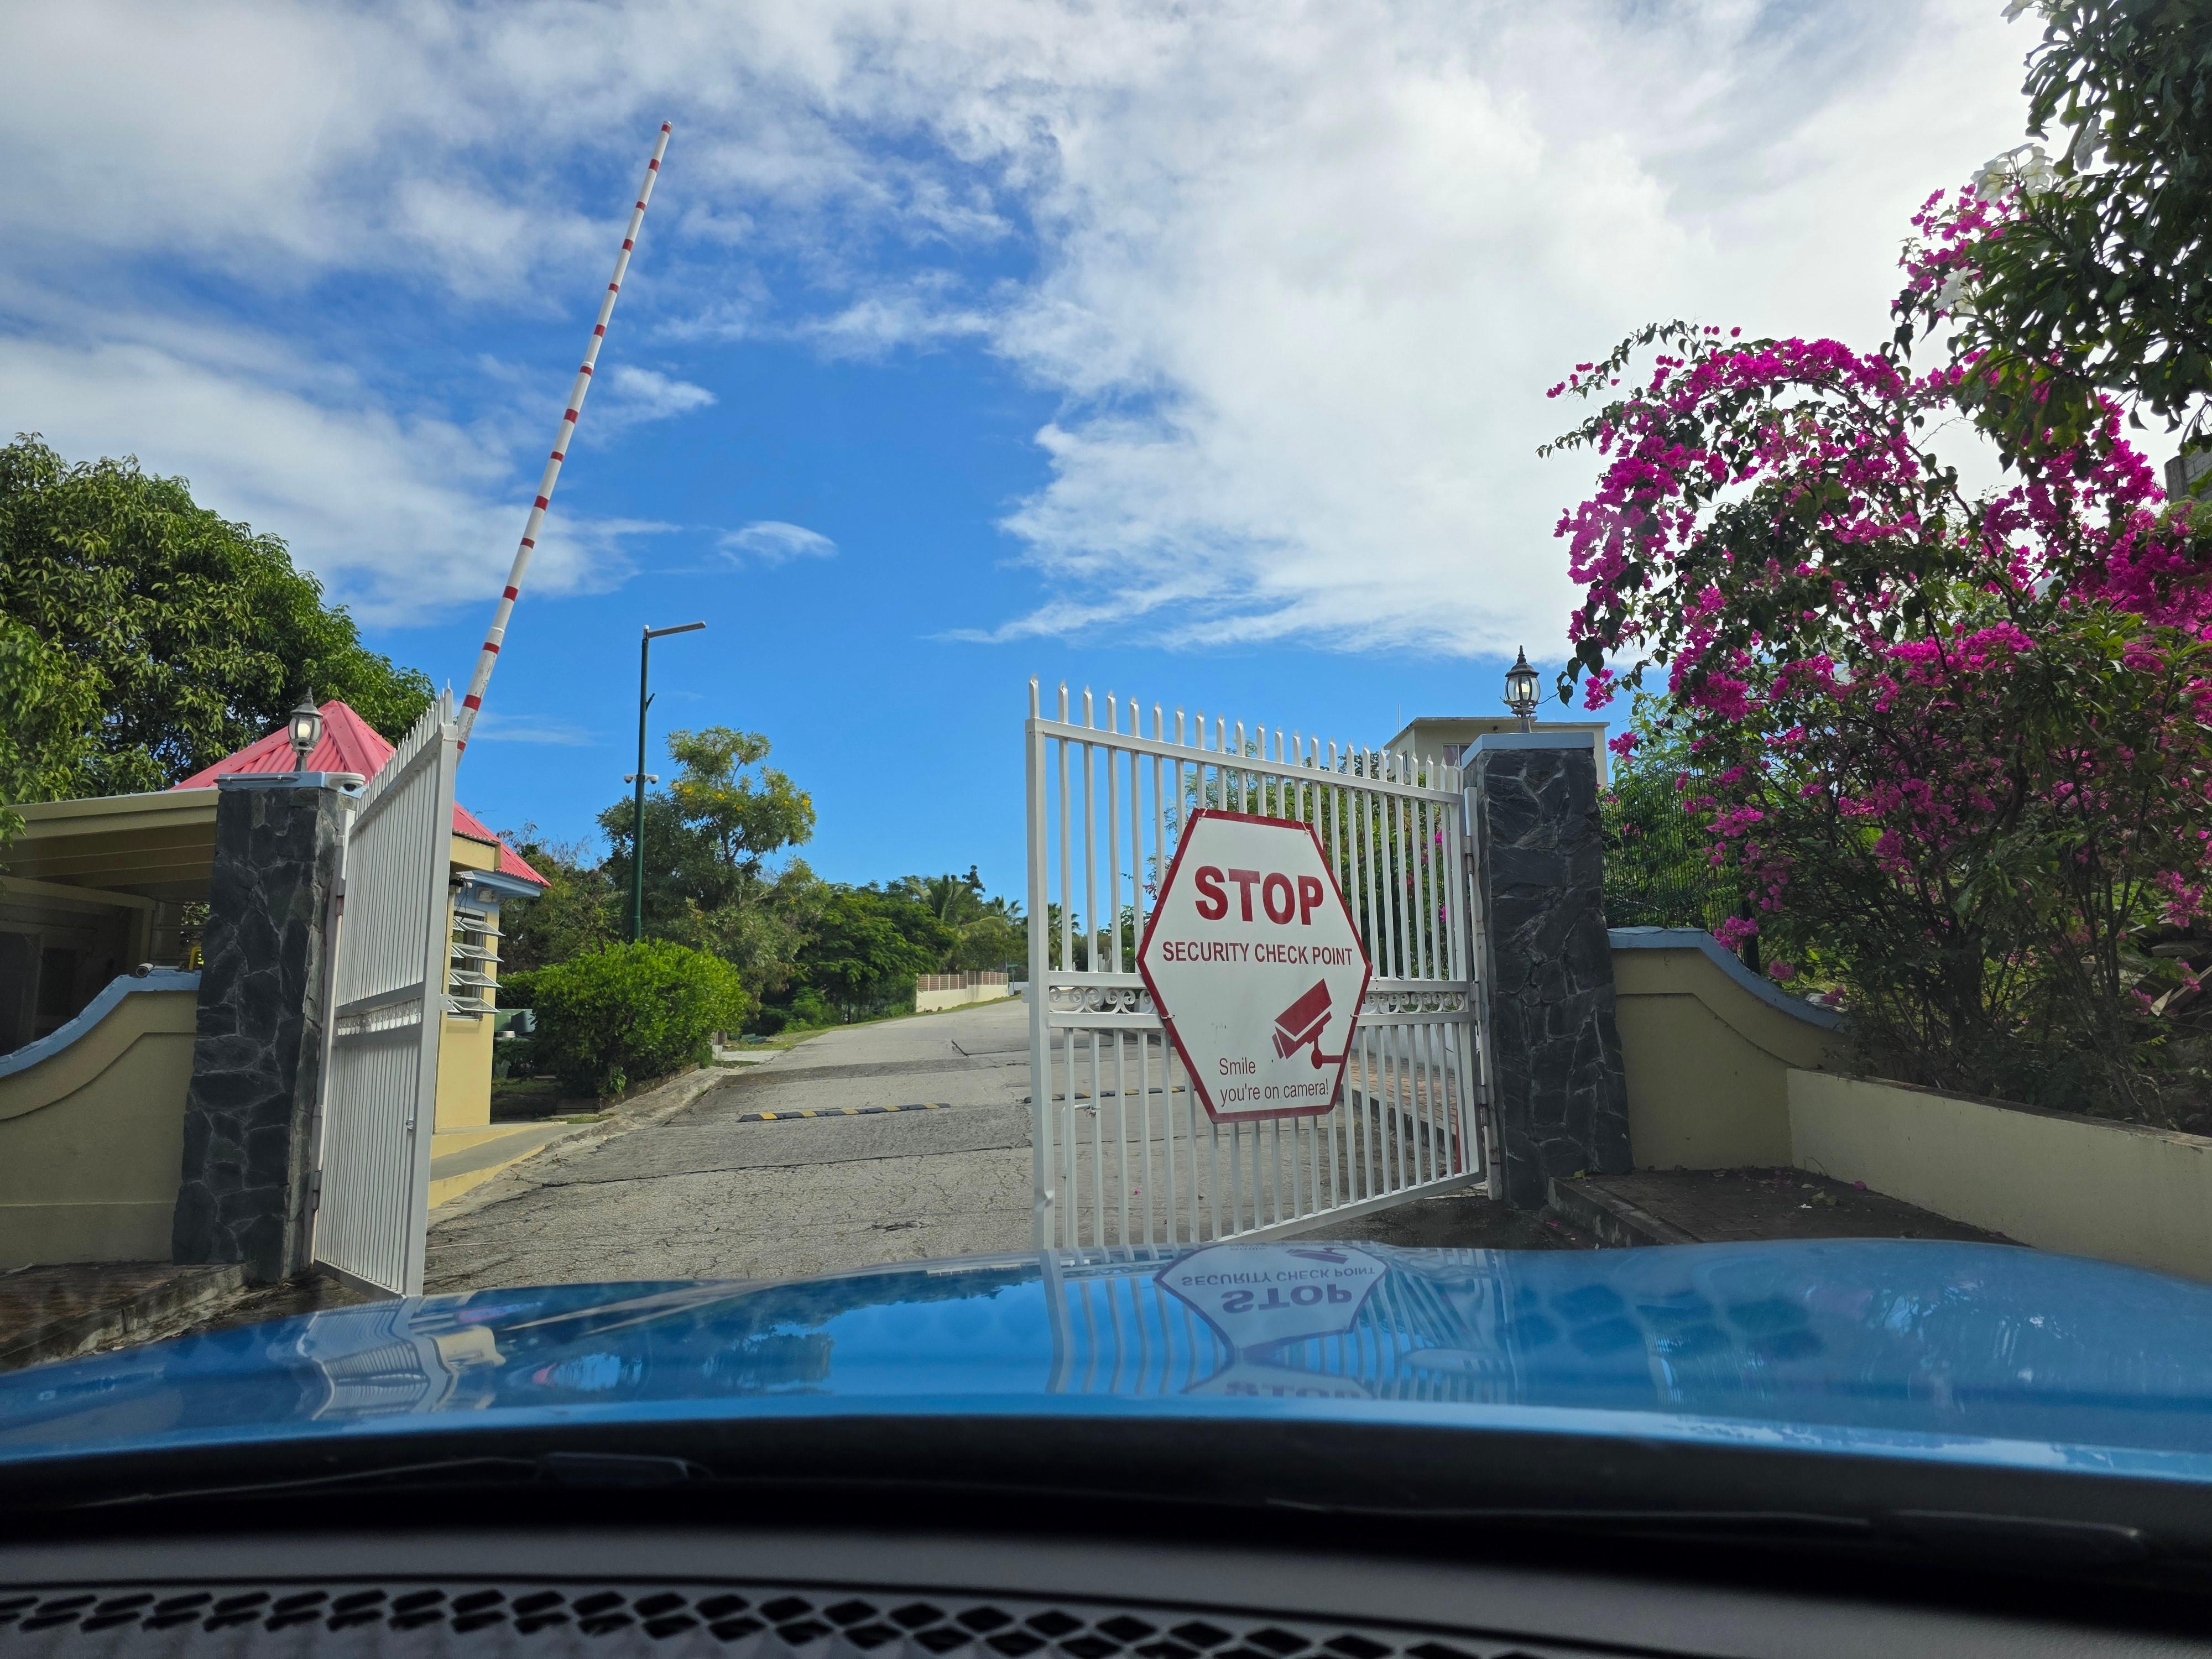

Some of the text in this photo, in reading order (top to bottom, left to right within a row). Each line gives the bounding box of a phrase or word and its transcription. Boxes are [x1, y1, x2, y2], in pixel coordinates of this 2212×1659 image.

[1194, 865, 1324, 926] STOP
[1162, 941, 1353, 966] SECURITY CHECK POINT
[1219, 1057, 1256, 1076] Smile
[1220, 1078, 1329, 1108] you're on camera!
